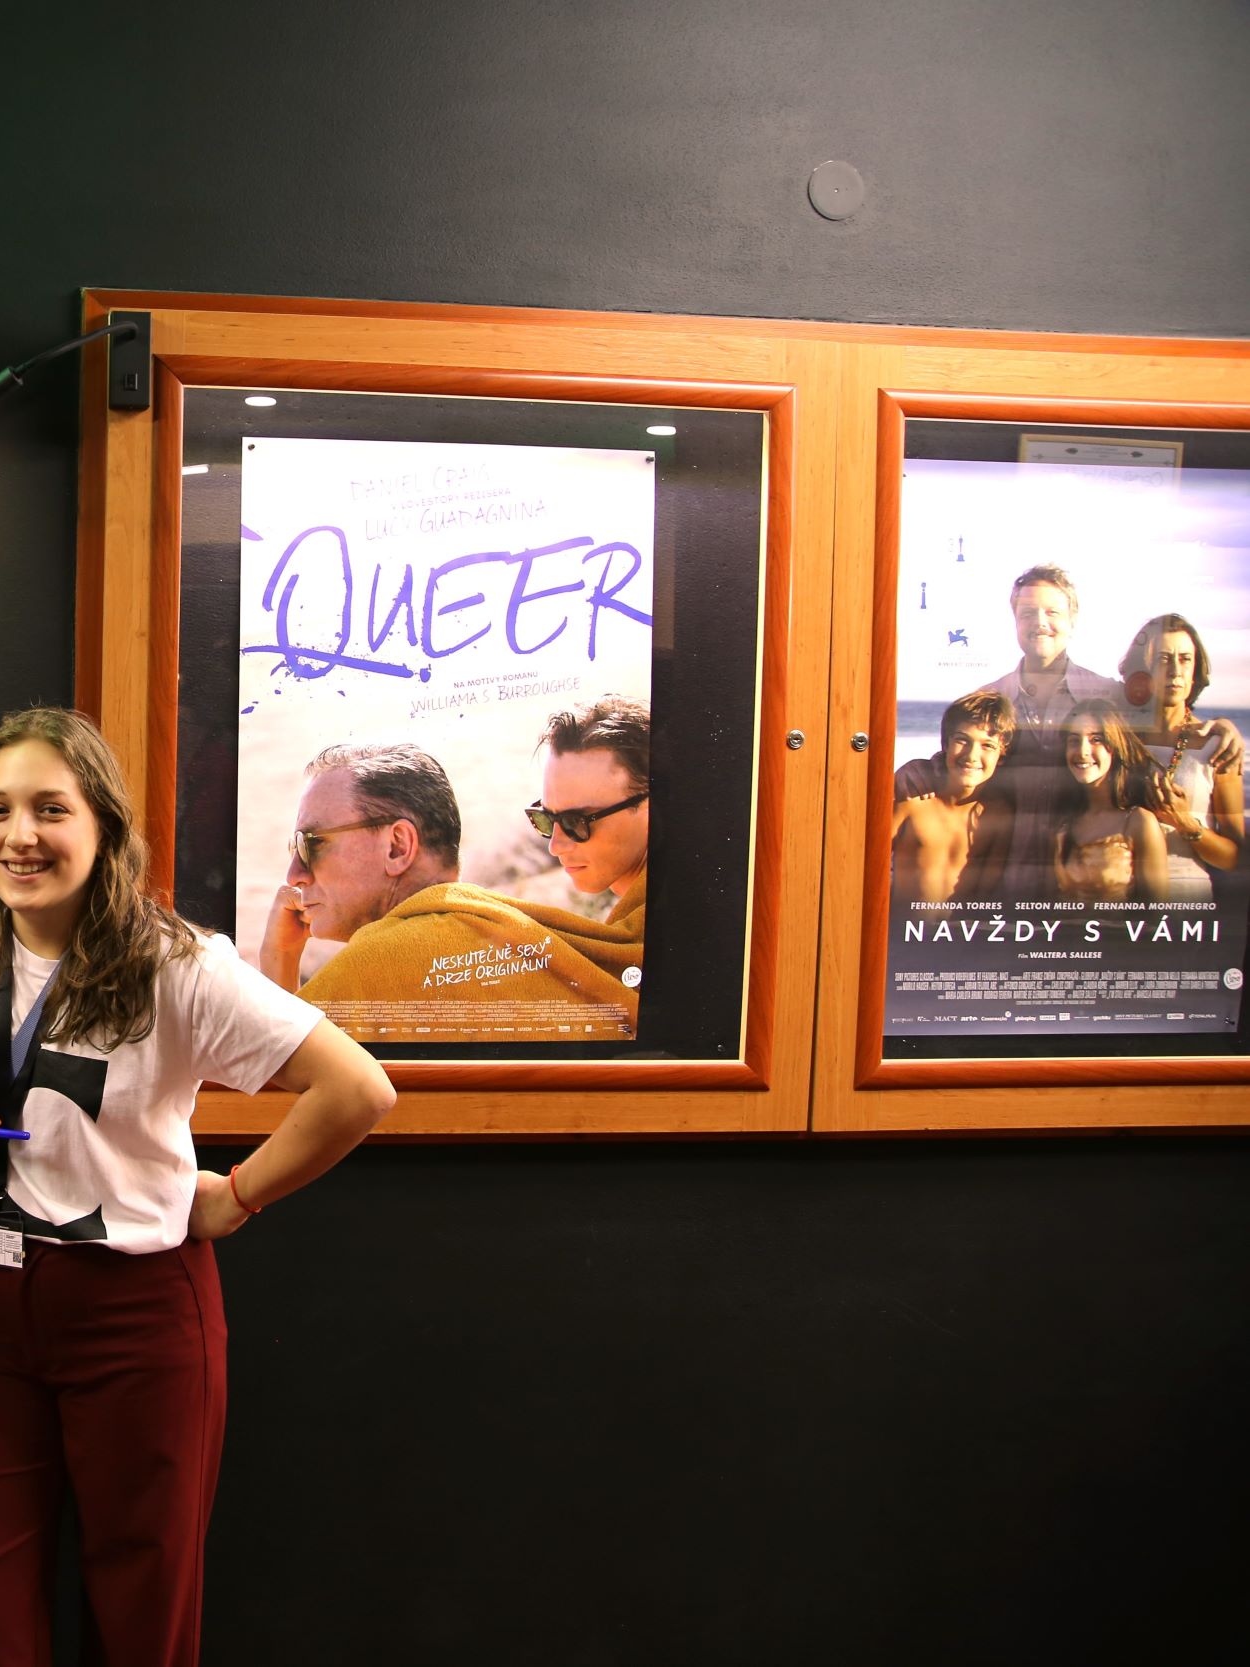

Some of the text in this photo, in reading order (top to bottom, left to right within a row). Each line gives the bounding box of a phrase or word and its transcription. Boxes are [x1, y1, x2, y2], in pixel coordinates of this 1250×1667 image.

[419, 499, 546, 533] GUADAGNINA
[241, 525, 653, 679] QUEER
[453, 671, 539, 689] NA MOTIVY ROMANU
[411, 692, 478, 713] WILLIAMA
[497, 677, 581, 701] BURROUGHSE
[910, 902, 1217, 911] FERNANDA TORRES SELTON MELLO FERNANDA MONTENEGRO
[904, 914, 1219, 942] NAVŽDY S VÁMI
[1029, 951, 1067, 959] WALTERA
[1069, 951, 1103, 959] SALLESE
[423, 976, 432, 988] A
[436, 969, 472, 986] DRZE
